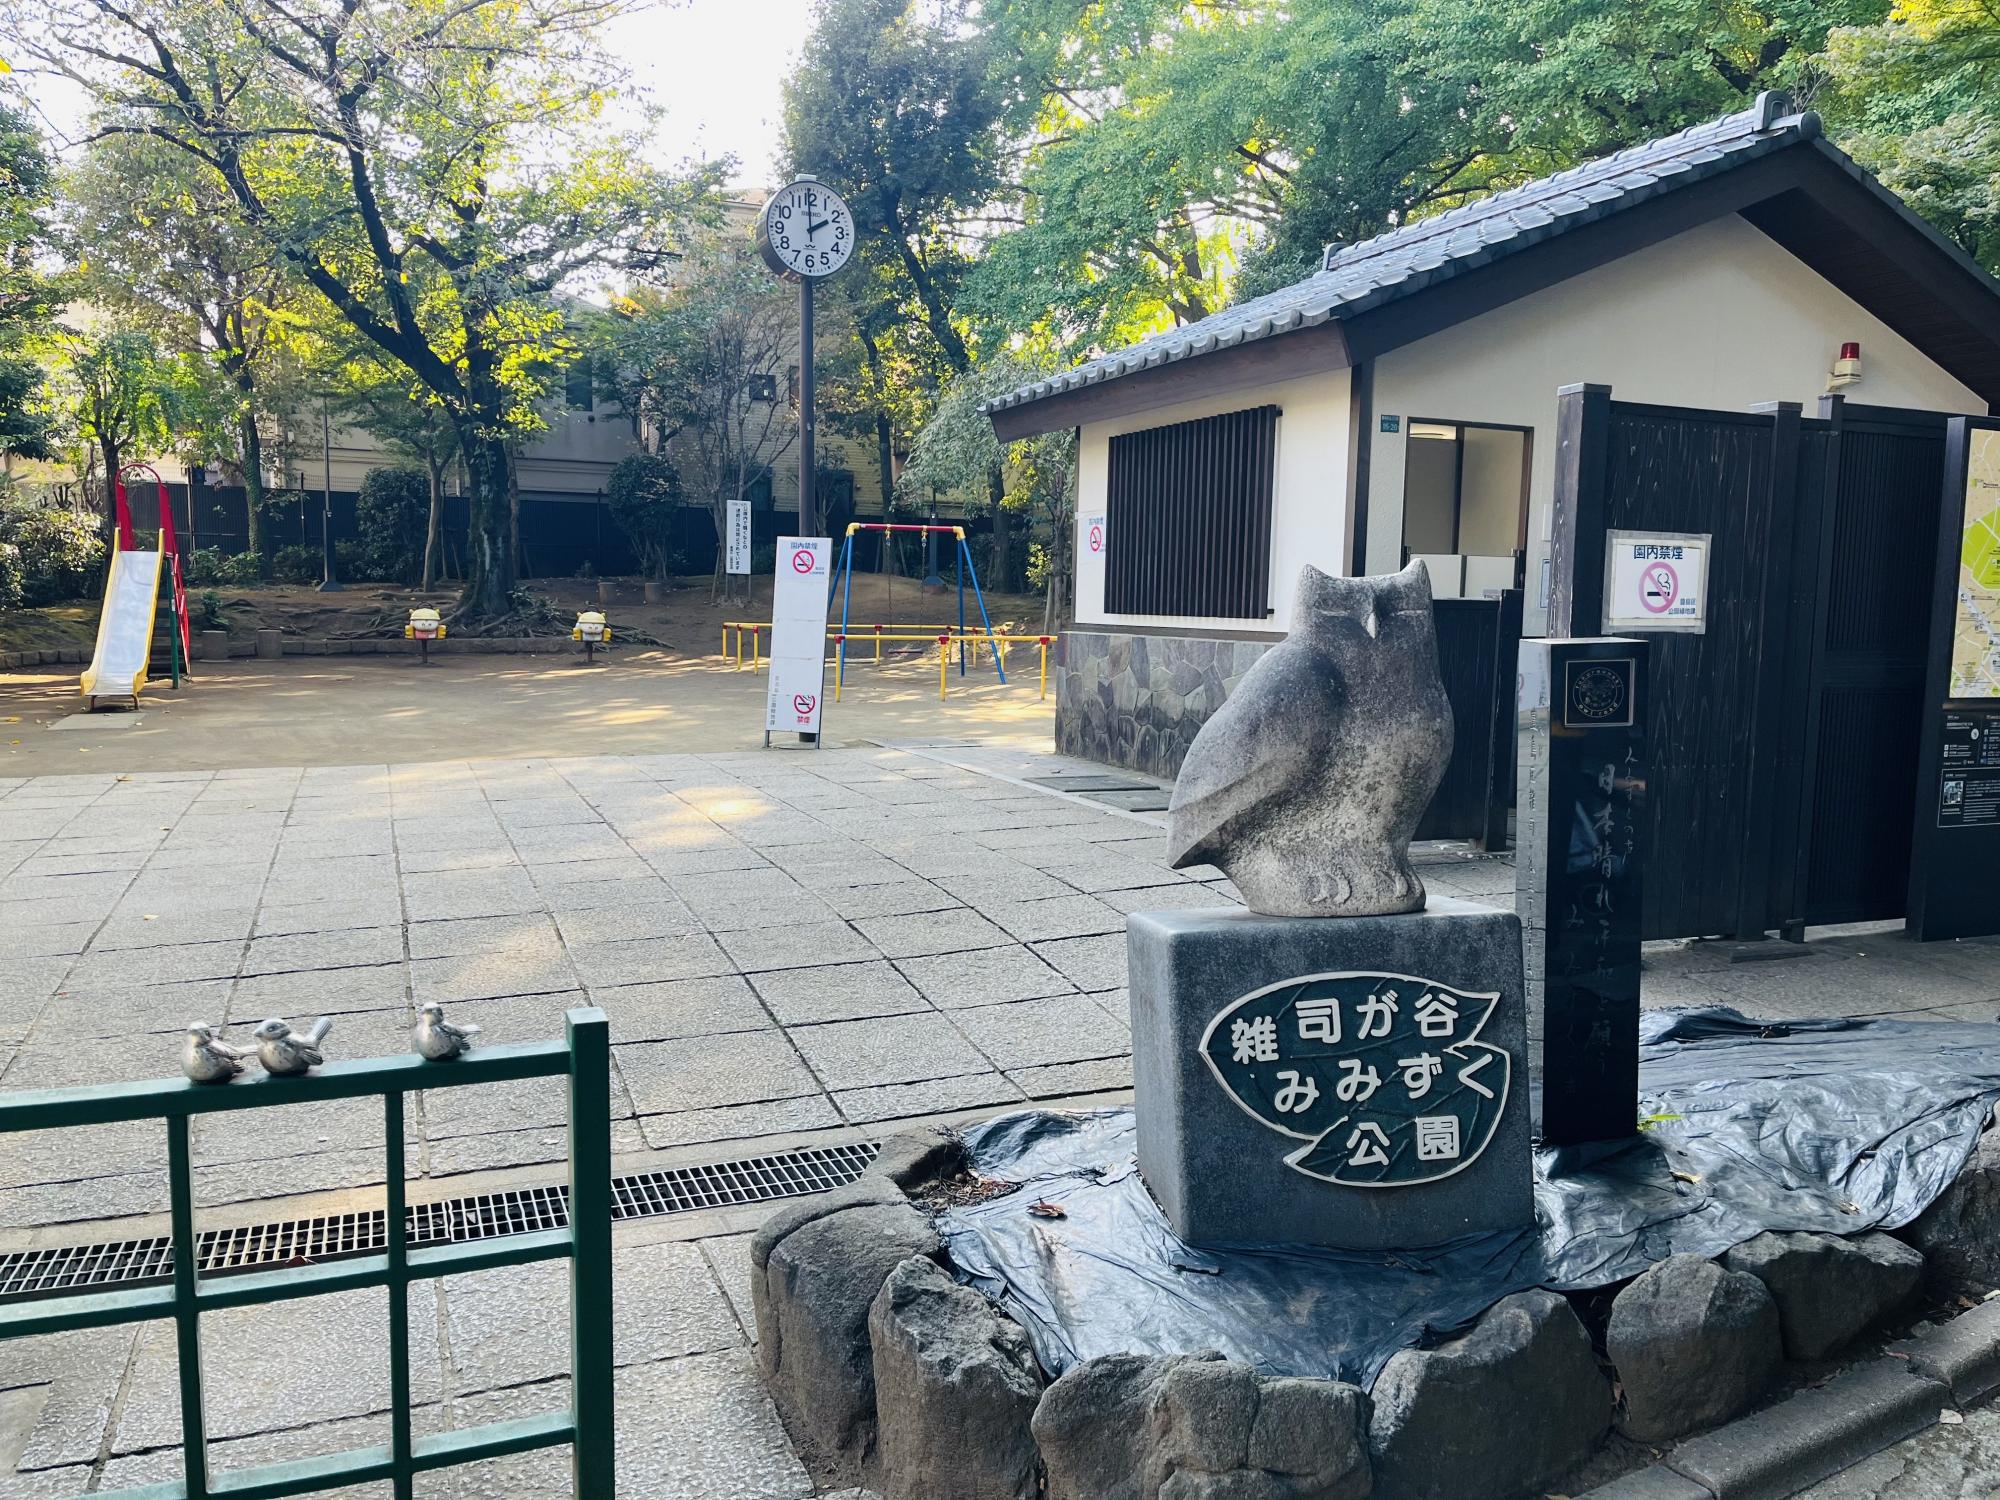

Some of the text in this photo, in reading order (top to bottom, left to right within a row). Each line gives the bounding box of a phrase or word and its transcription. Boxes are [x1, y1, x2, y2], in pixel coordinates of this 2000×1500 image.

[792, 194, 801, 208] 11
[805, 192, 817, 207] 12
[823, 198, 827, 211] 1
[779, 205, 791, 219] 10
[801, 210, 821, 218] SEKO
[831, 210, 840, 223] 2
[774, 221, 784, 234] 9
[835, 226, 845, 240] 3
[780, 236, 790, 249] 8
[831, 242, 840, 254] 4
[792, 249, 801, 262] 7
[805, 254, 815, 268] 6
[820, 252, 829, 265] 5
[1634, 545, 1684, 559] 園内禁煙
[1231, 990, 1459, 1065] 雑司が谷
[1274, 1052, 1494, 1114] みみずく
[1346, 1115, 1460, 1167] 公園
